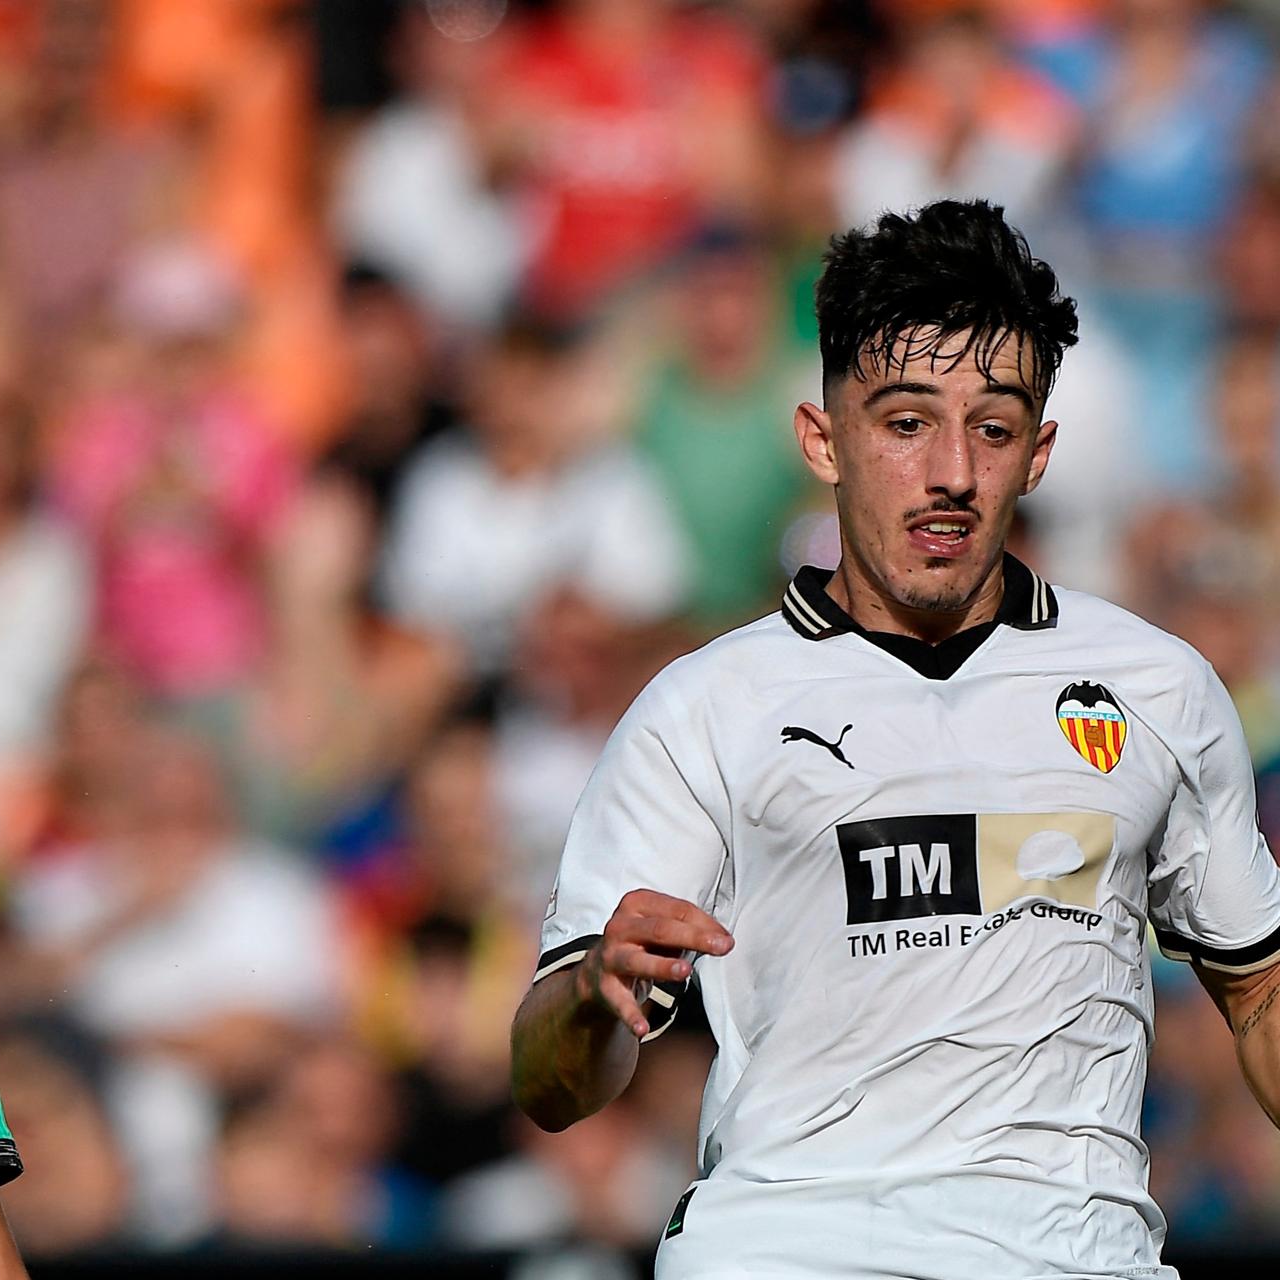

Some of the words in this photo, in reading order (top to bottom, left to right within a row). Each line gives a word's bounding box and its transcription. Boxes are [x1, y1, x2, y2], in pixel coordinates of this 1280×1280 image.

[858, 843, 952, 900] TM
[847, 933, 886, 957] TM
[896, 925, 950, 951] Real
